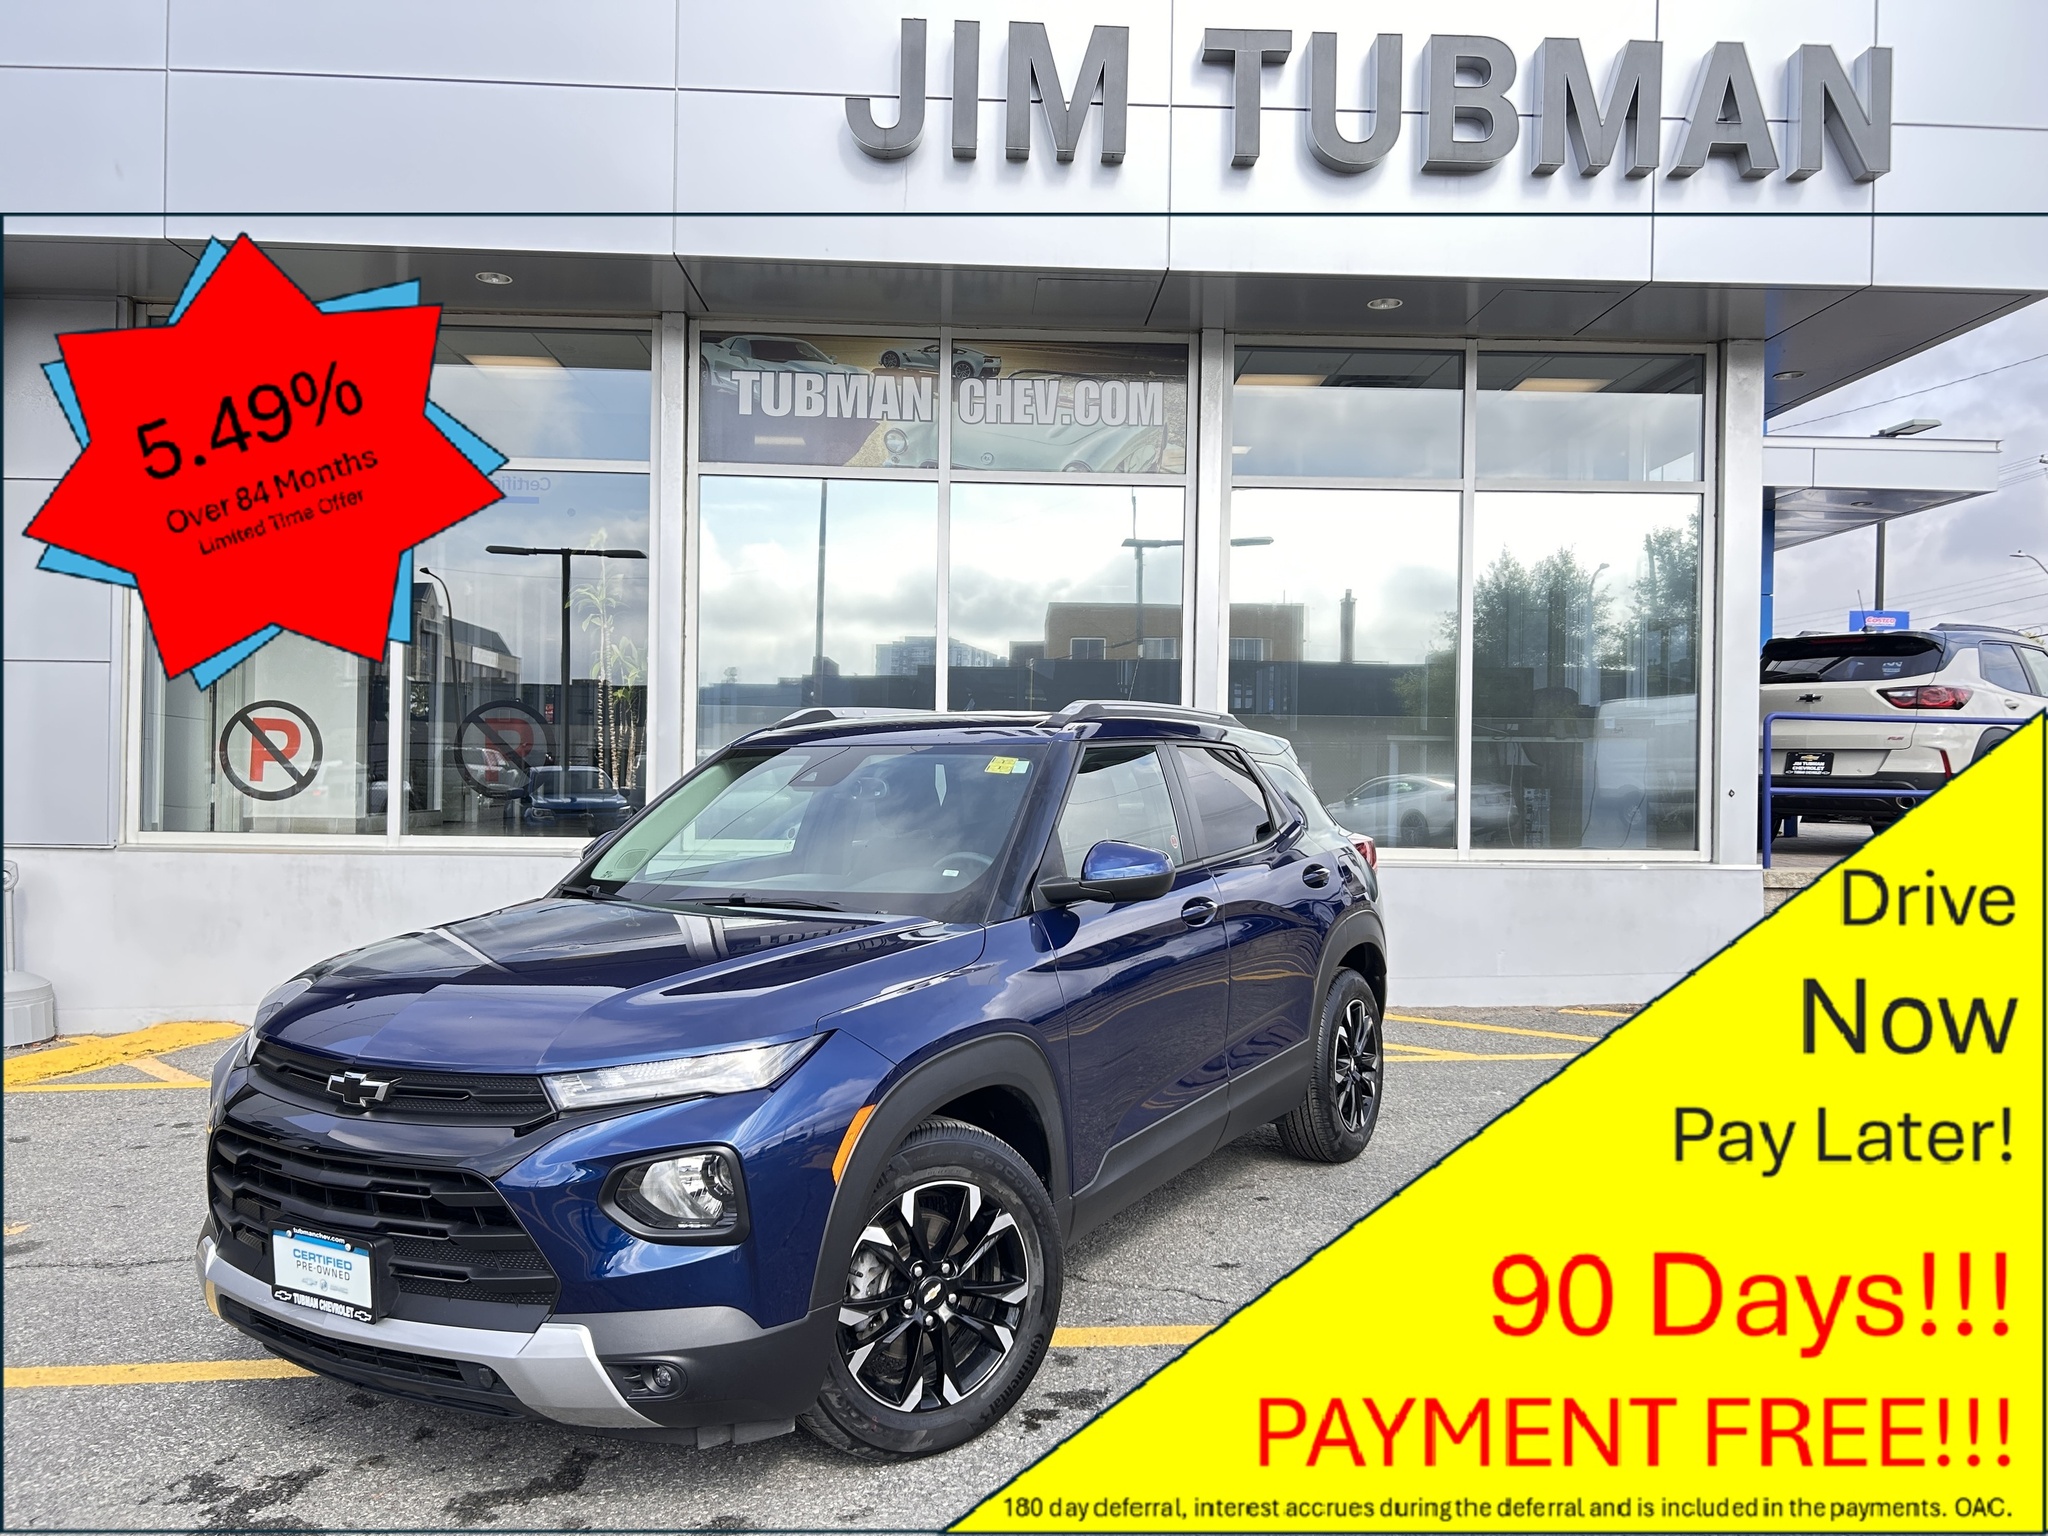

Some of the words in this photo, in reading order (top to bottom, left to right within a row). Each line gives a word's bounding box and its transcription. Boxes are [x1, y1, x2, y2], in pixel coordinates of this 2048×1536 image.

[845, 17, 1130, 164] JIM
[1201, 27, 1893, 184] TUBMAN
[730, 369, 933, 422] TUBMAN
[958, 377, 1165, 427] CHEV.COM
[293, 1227, 345, 1244] tubmanchev.com
[293, 1249, 352, 1270] CERTIFIED
[297, 1260, 350, 1281] PRE-OWNED
[293, 1293, 318, 1310] TUBMAN
[319, 1298, 354, 1318] CHEVROLET
